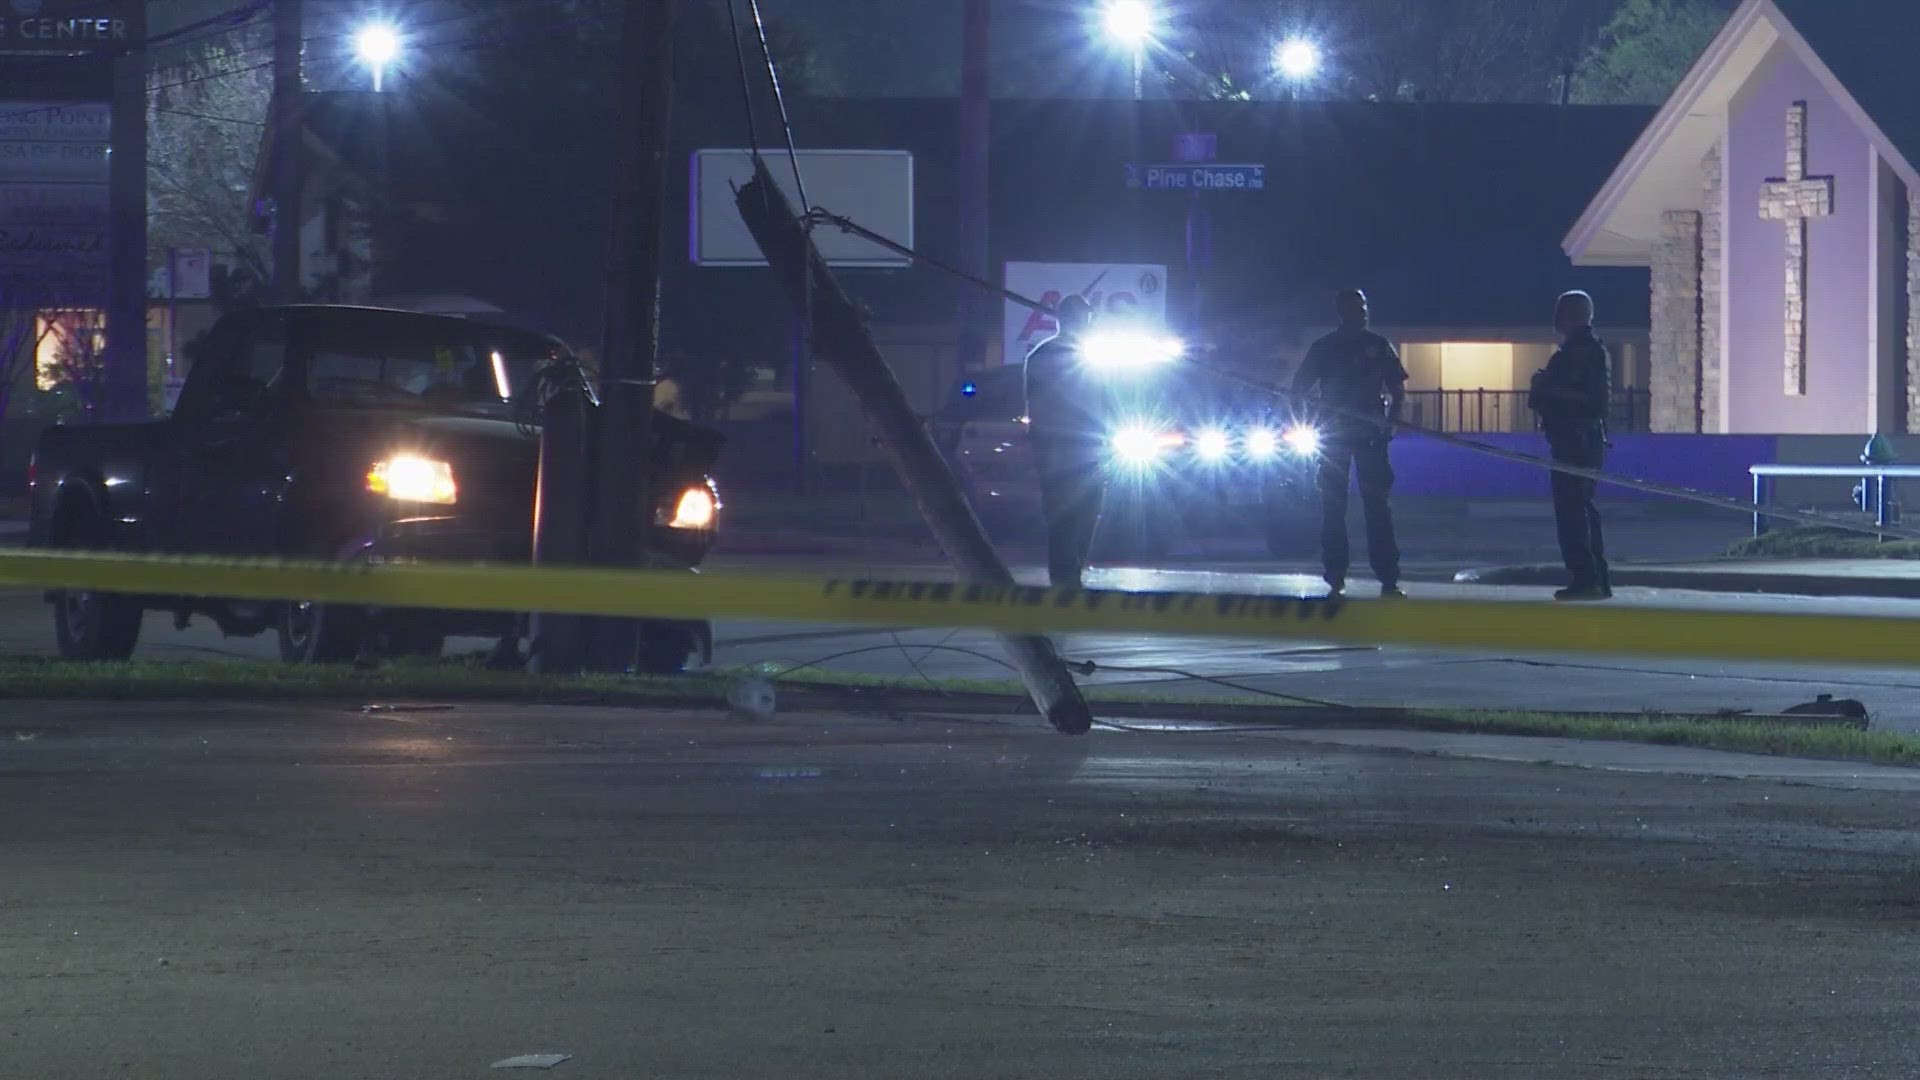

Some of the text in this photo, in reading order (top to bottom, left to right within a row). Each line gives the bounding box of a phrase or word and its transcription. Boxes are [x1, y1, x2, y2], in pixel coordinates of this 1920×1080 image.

[20, 18, 127, 39] CENTER
[1147, 167, 1187, 188] Pine
[1191, 167, 1245, 188] Chase
